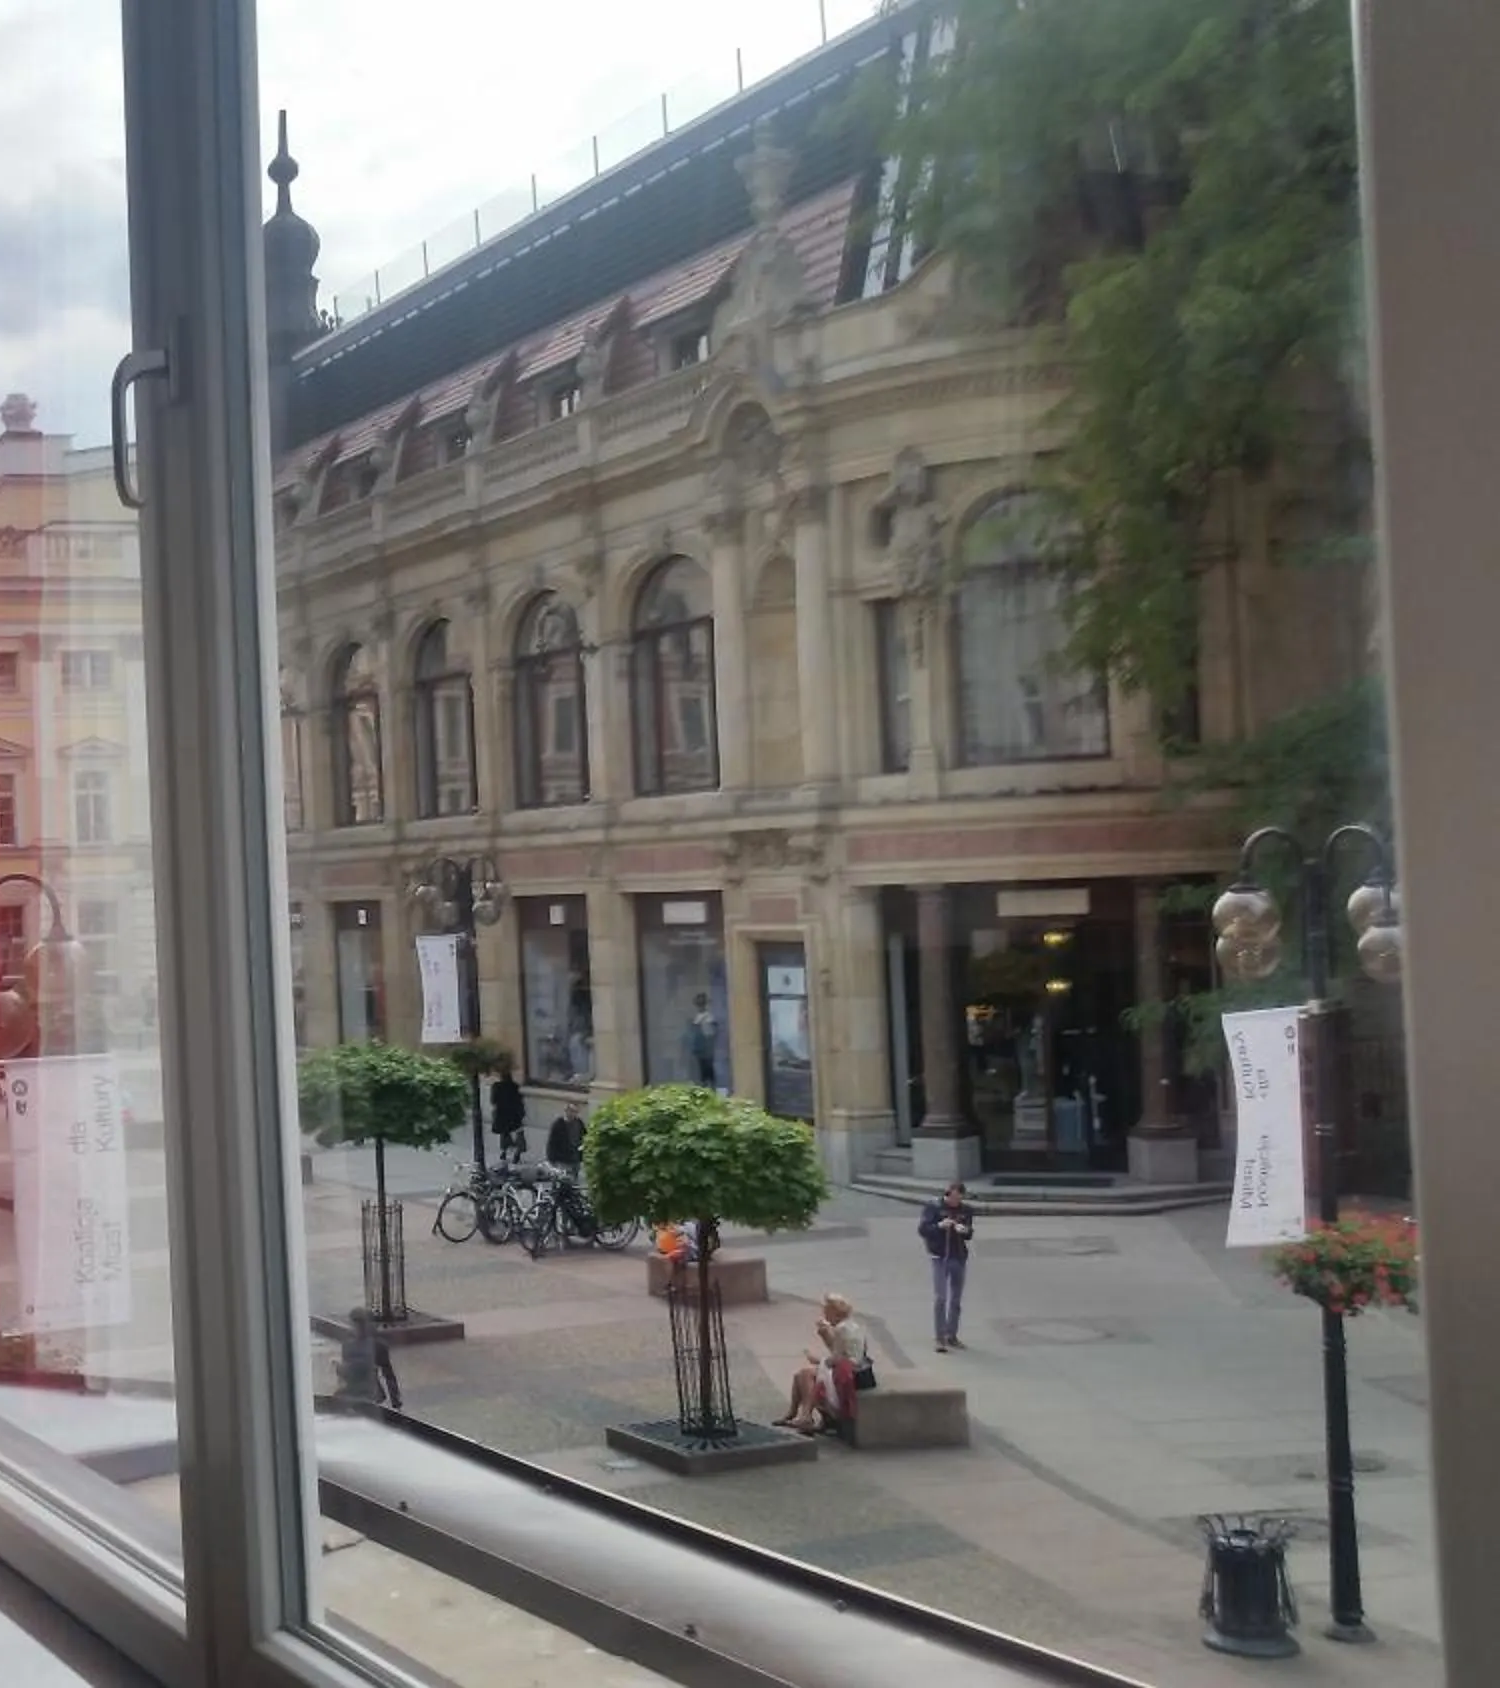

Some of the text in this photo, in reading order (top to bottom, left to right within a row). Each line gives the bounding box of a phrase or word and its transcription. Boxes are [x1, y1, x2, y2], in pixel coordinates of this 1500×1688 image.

[92, 1075, 117, 1153] Kultury
[67, 1120, 99, 1285] Koalicja dla
